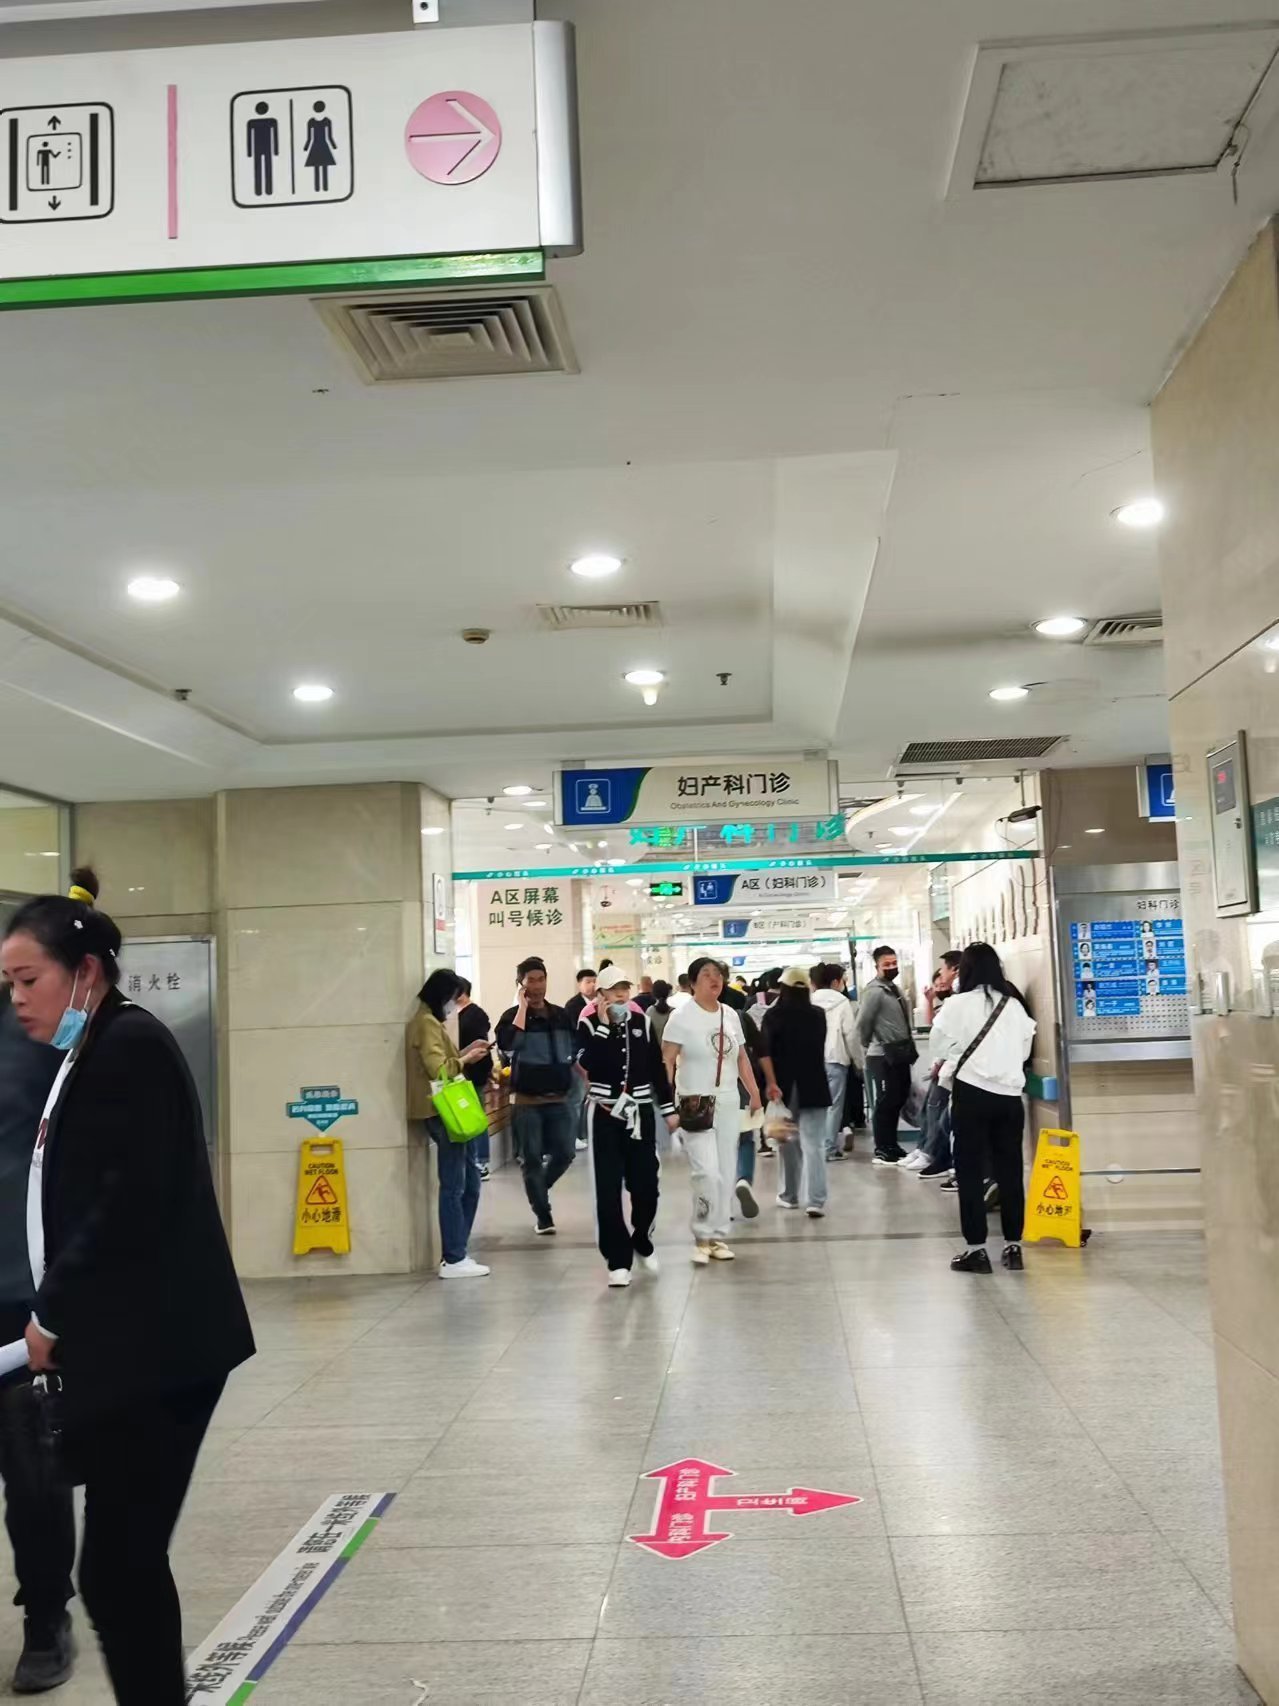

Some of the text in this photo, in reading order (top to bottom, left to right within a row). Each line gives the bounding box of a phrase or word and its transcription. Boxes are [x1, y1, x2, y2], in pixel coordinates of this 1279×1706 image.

[678, 772, 791, 796] 妇产科门诊
[711, 799, 728, 808] And
[776, 798, 799, 806] Clinic
[742, 876, 826, 890] A区（妇科门诊）
[490, 887, 559, 906] A区屏幕
[1137, 899, 1180, 910] 妇科门诊
[489, 908, 563, 928] 叫号候诊
[128, 973, 181, 992] 消火栓
[301, 1207, 342, 1223] 小心地滑
[296, 1494, 371, 1554] 请您在一米线外等候
